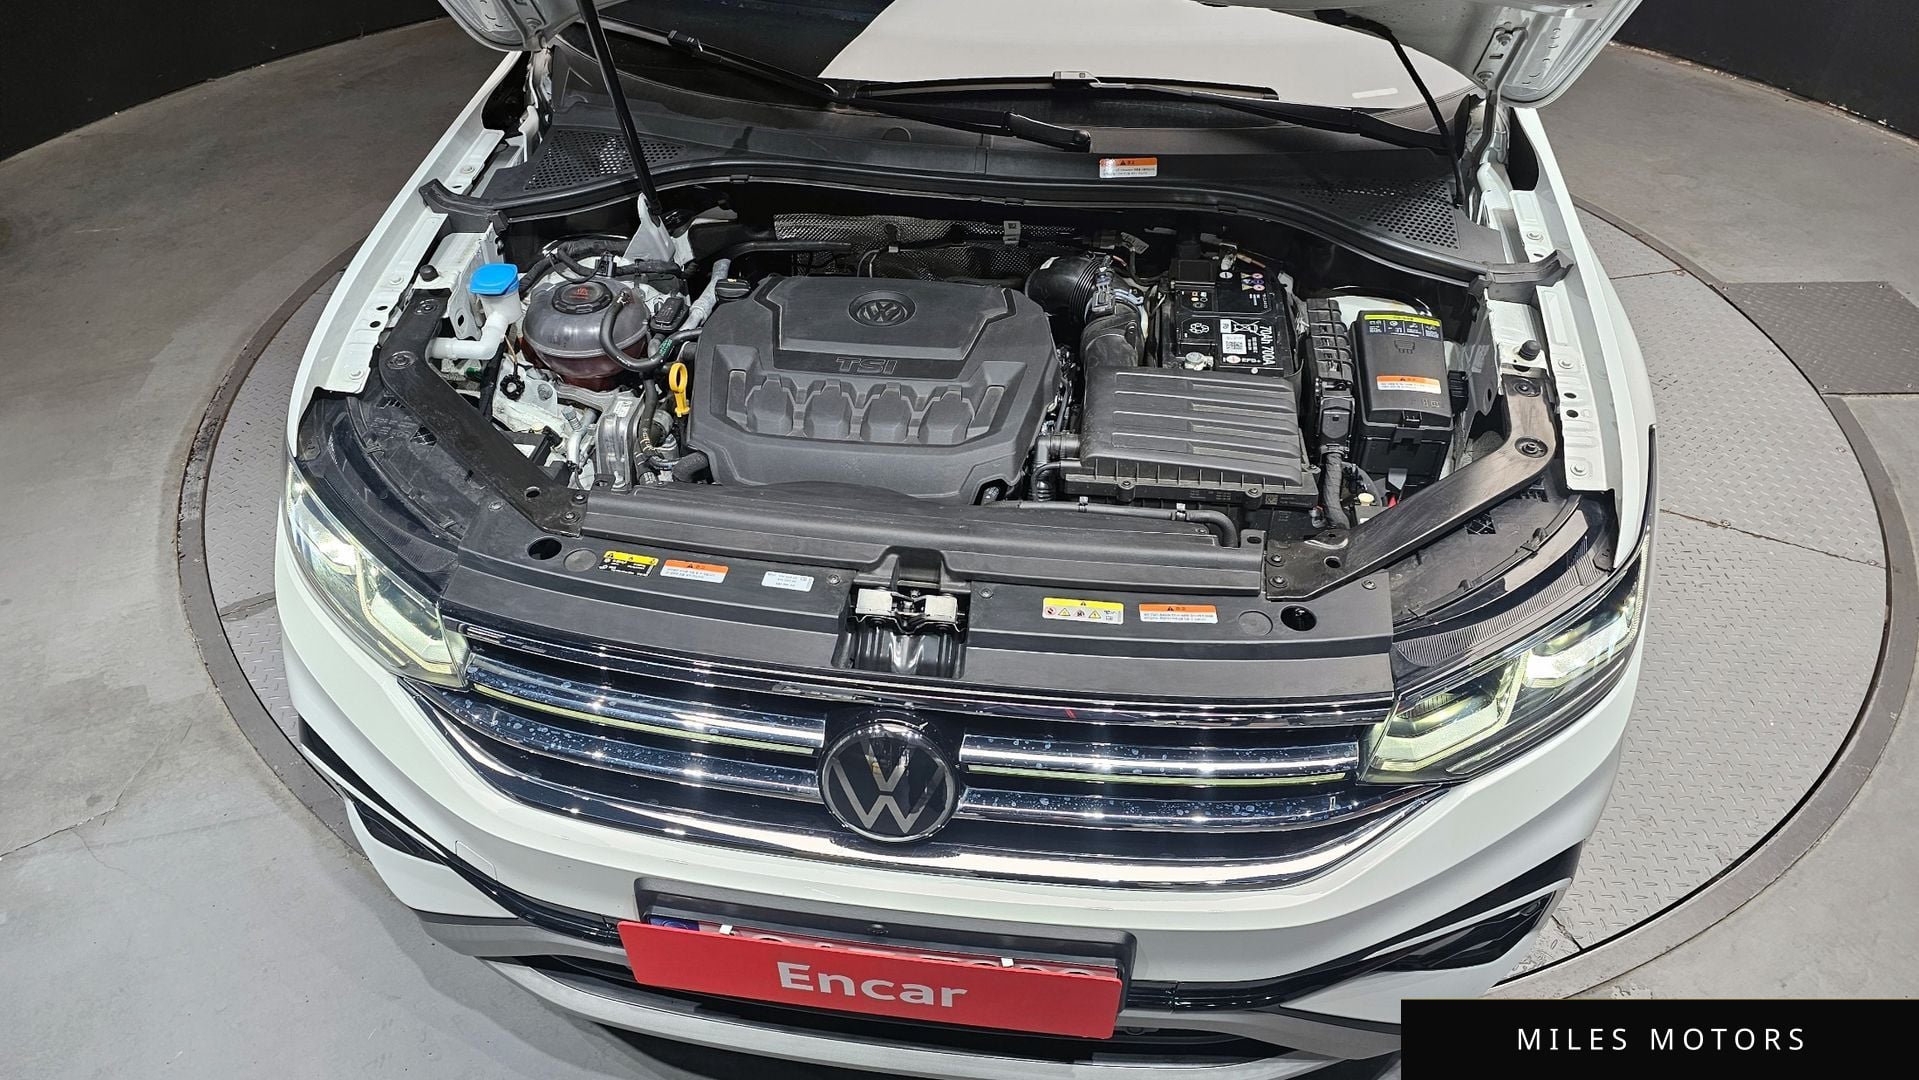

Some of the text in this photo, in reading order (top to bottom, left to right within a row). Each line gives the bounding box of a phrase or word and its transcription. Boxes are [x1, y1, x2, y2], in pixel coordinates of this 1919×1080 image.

[836, 356, 898, 376] TSI
[1259, 325, 1276, 366] 70Ah 700A
[776, 961, 968, 1008] Encar
